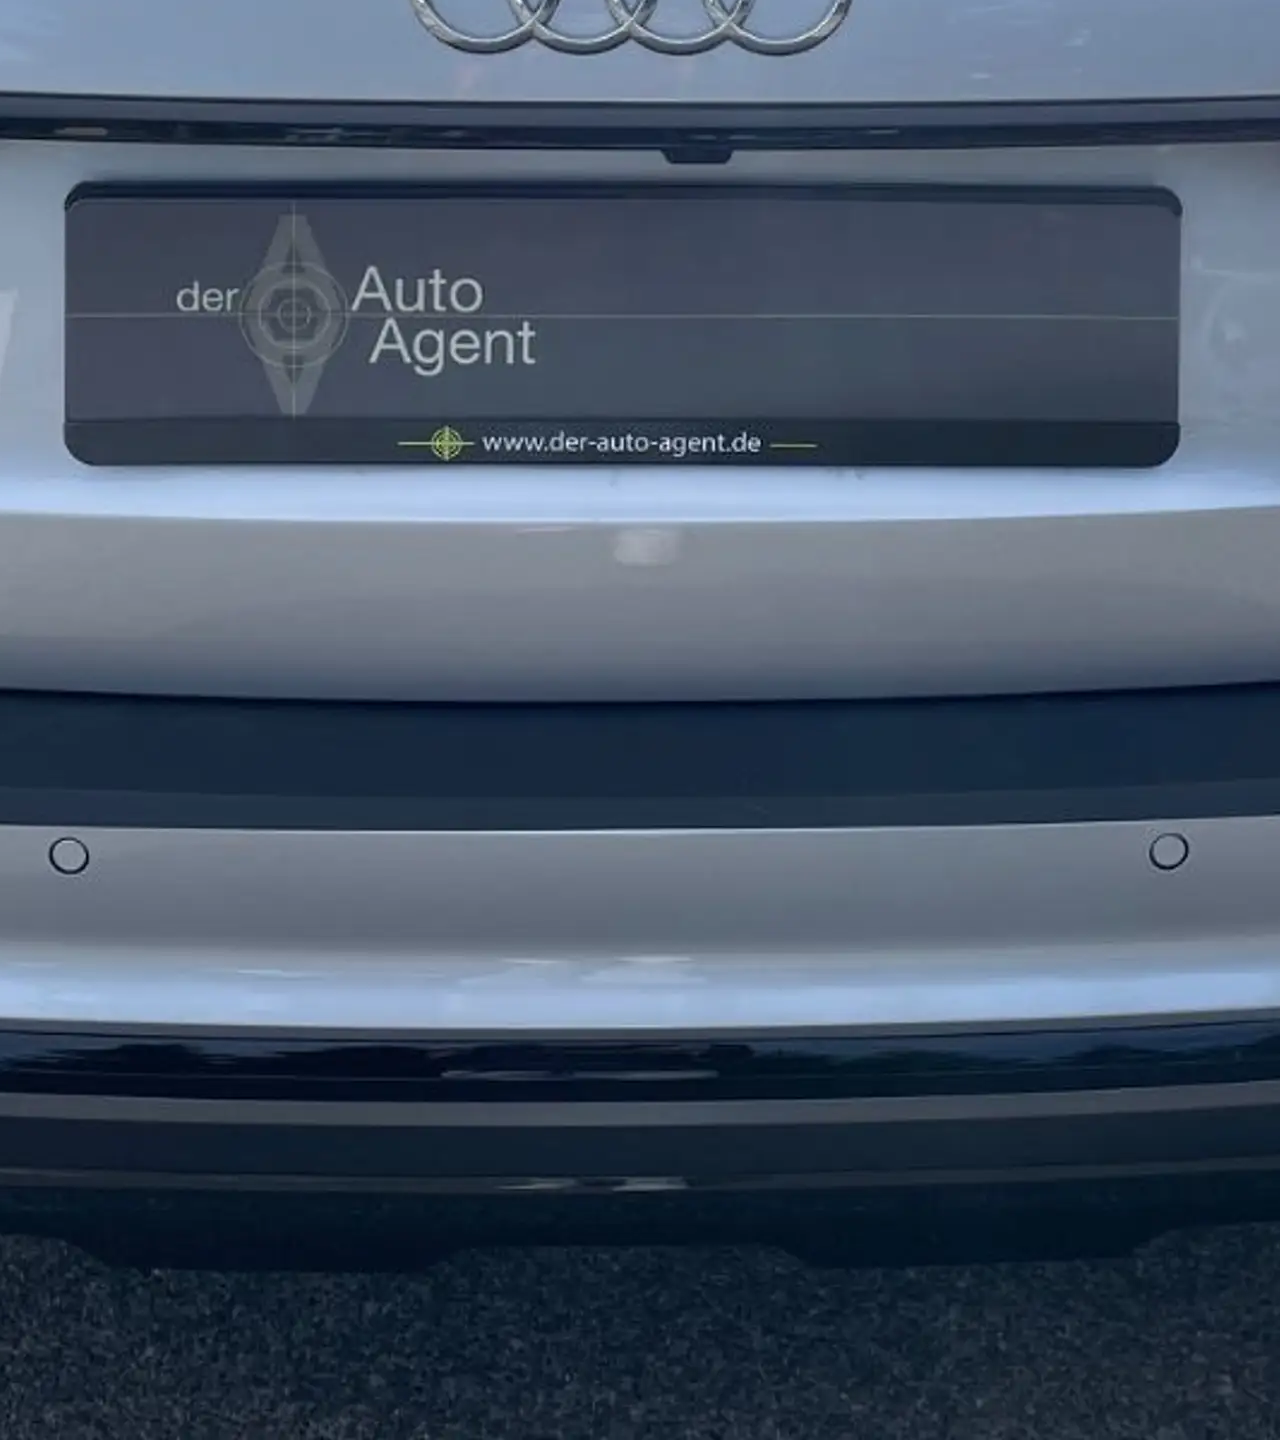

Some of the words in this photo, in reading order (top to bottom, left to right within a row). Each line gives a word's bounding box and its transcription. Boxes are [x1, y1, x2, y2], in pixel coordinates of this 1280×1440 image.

[176, 281, 239, 312] der
[351, 265, 484, 312] Auto
[369, 317, 537, 377] Agent
[481, 432, 763, 458] www.der-auto-agent.de
